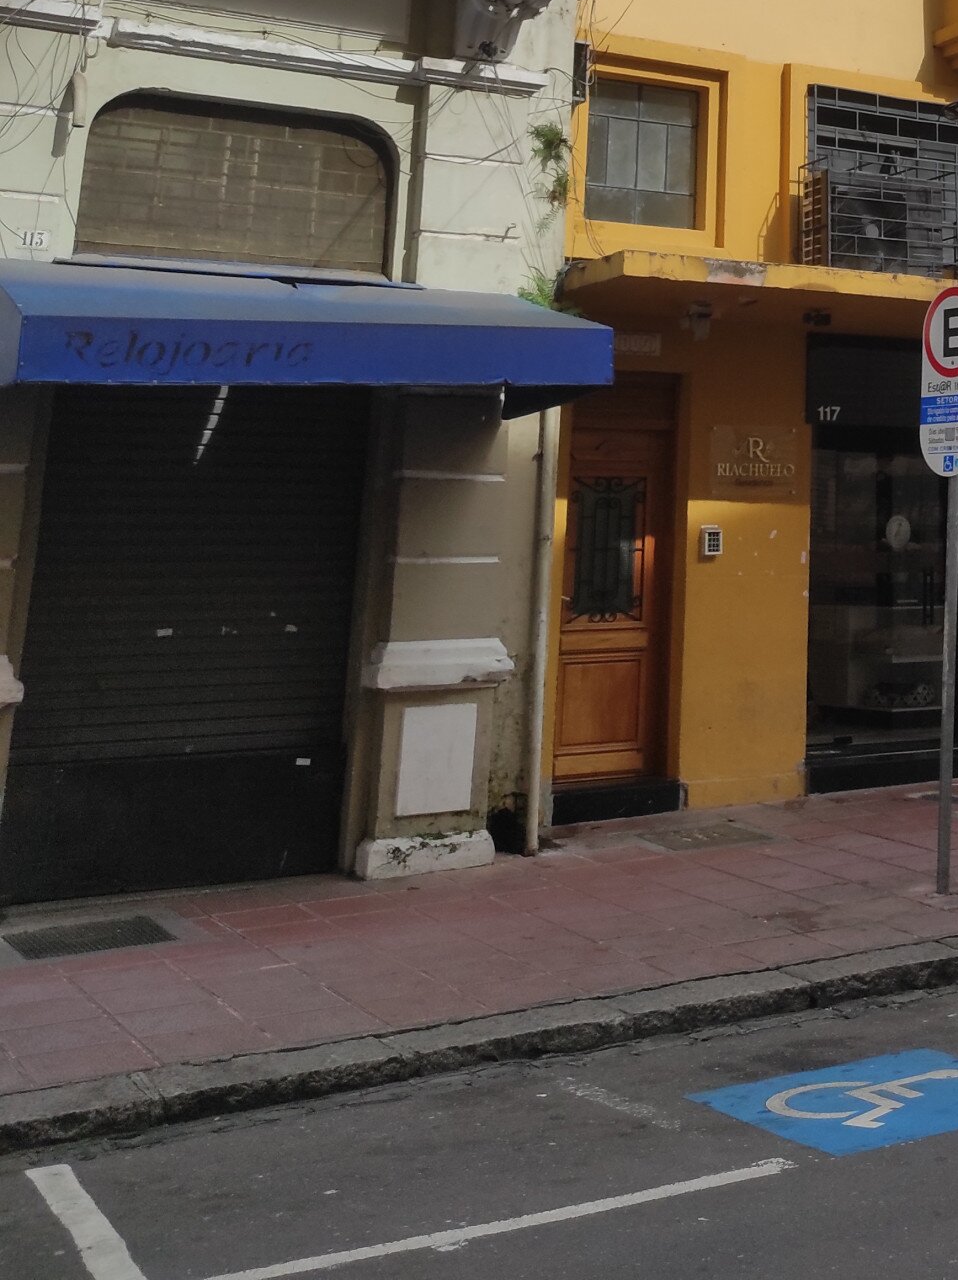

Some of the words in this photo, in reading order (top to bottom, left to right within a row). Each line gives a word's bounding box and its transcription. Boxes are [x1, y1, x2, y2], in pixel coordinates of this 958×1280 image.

[936, 396, 958, 405] SETOR
[817, 406, 841, 421] 117
[748, 437, 769, 462] R
[717, 462, 796, 478] RIACHUELO
